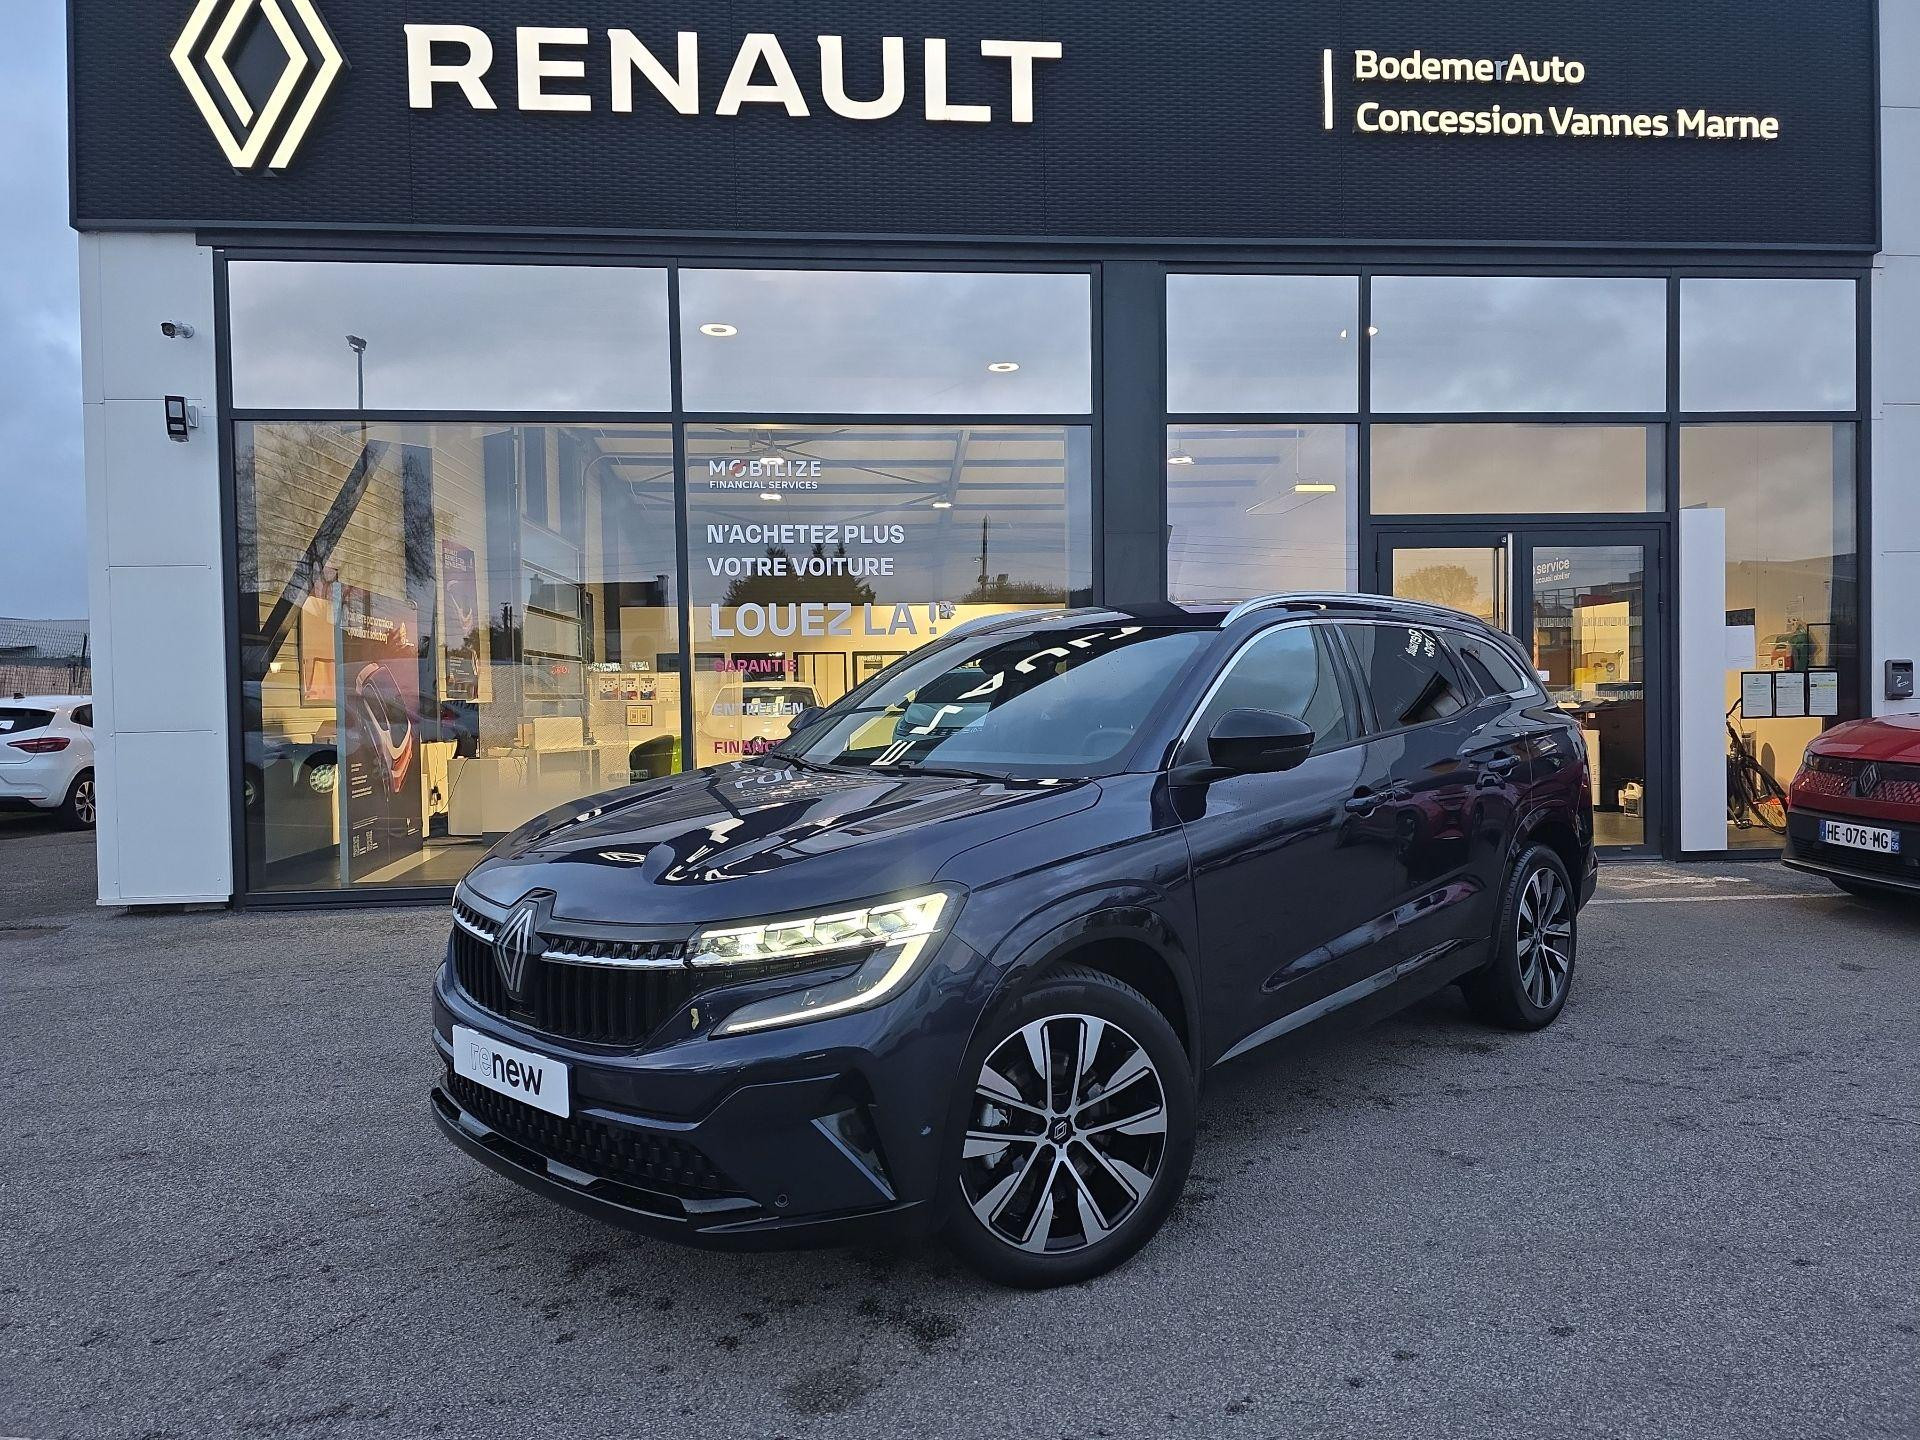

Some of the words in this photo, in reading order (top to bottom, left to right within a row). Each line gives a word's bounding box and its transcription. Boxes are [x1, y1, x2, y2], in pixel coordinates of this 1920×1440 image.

[403, 23, 1063, 123] RENAULT
[1354, 49, 1586, 84] BodemerAuto
[1355, 102, 1544, 136] Concession
[1548, 107, 1669, 137] Vannes
[1676, 109, 1780, 140] Marne
[709, 459, 822, 478] MOBILIZE
[709, 481, 767, 489] FINANCIAL
[768, 481, 818, 489] SERVICES
[707, 524, 840, 544] N'ACHETEZ
[844, 524, 905, 544] PLUS
[707, 557, 788, 576] VOTRE
[792, 557, 894, 576] VOITURE
[1536, 557, 1570, 575] service
[710, 602, 852, 637] LOUEZ
[864, 602, 918, 635] LA
[714, 659, 797, 673] GARANTIE
[713, 702, 804, 716] ENTRETIEN
[470, 1043, 543, 1096] renew
